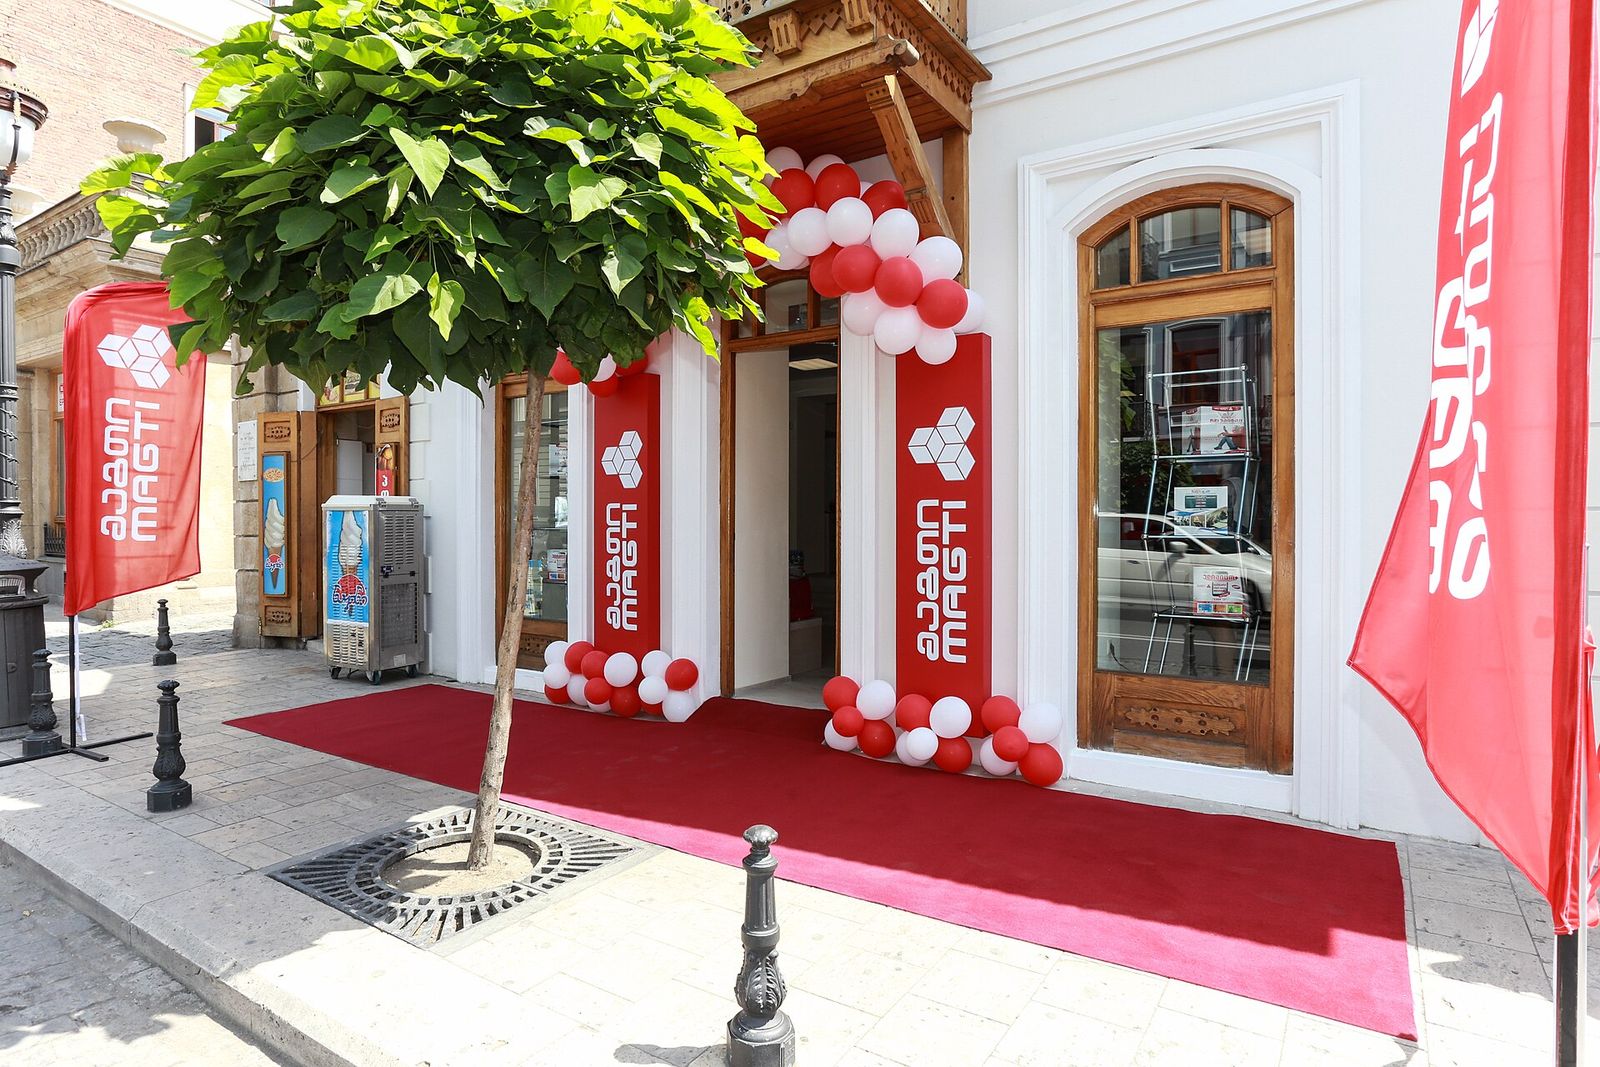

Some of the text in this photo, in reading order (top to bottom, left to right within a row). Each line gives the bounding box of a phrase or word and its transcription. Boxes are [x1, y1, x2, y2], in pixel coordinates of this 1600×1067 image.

[100, 397, 131, 541] მაგთი
[131, 399, 161, 542] MAGTI
[606, 503, 621, 631] მაგთი
[622, 503, 638, 632] MAGTI
[917, 499, 940, 662] მაგთი
[942, 500, 968, 664] MAGTI
